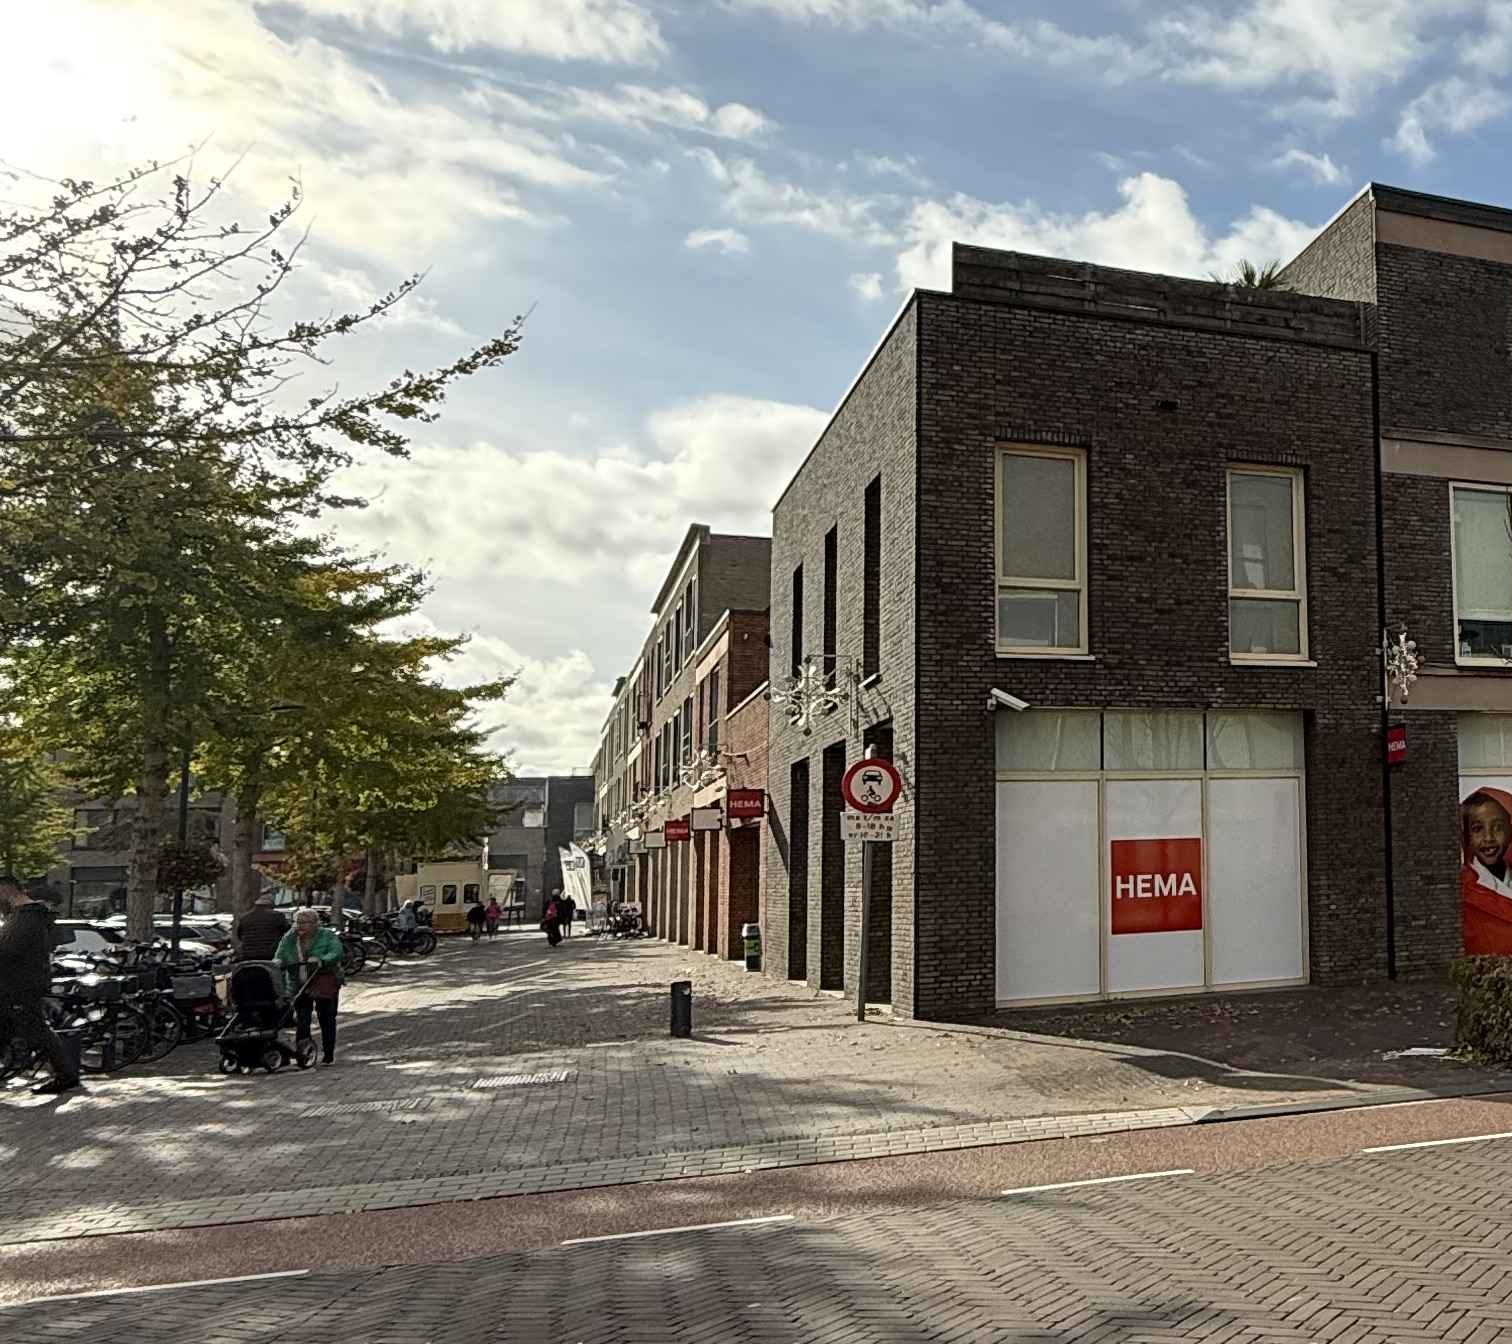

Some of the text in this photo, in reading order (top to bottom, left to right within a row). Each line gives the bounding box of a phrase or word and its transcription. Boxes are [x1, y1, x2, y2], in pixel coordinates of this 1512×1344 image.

[1387, 740, 1407, 752] HEMA
[729, 800, 762, 809] HEMA
[1115, 872, 1198, 899] HEMA
